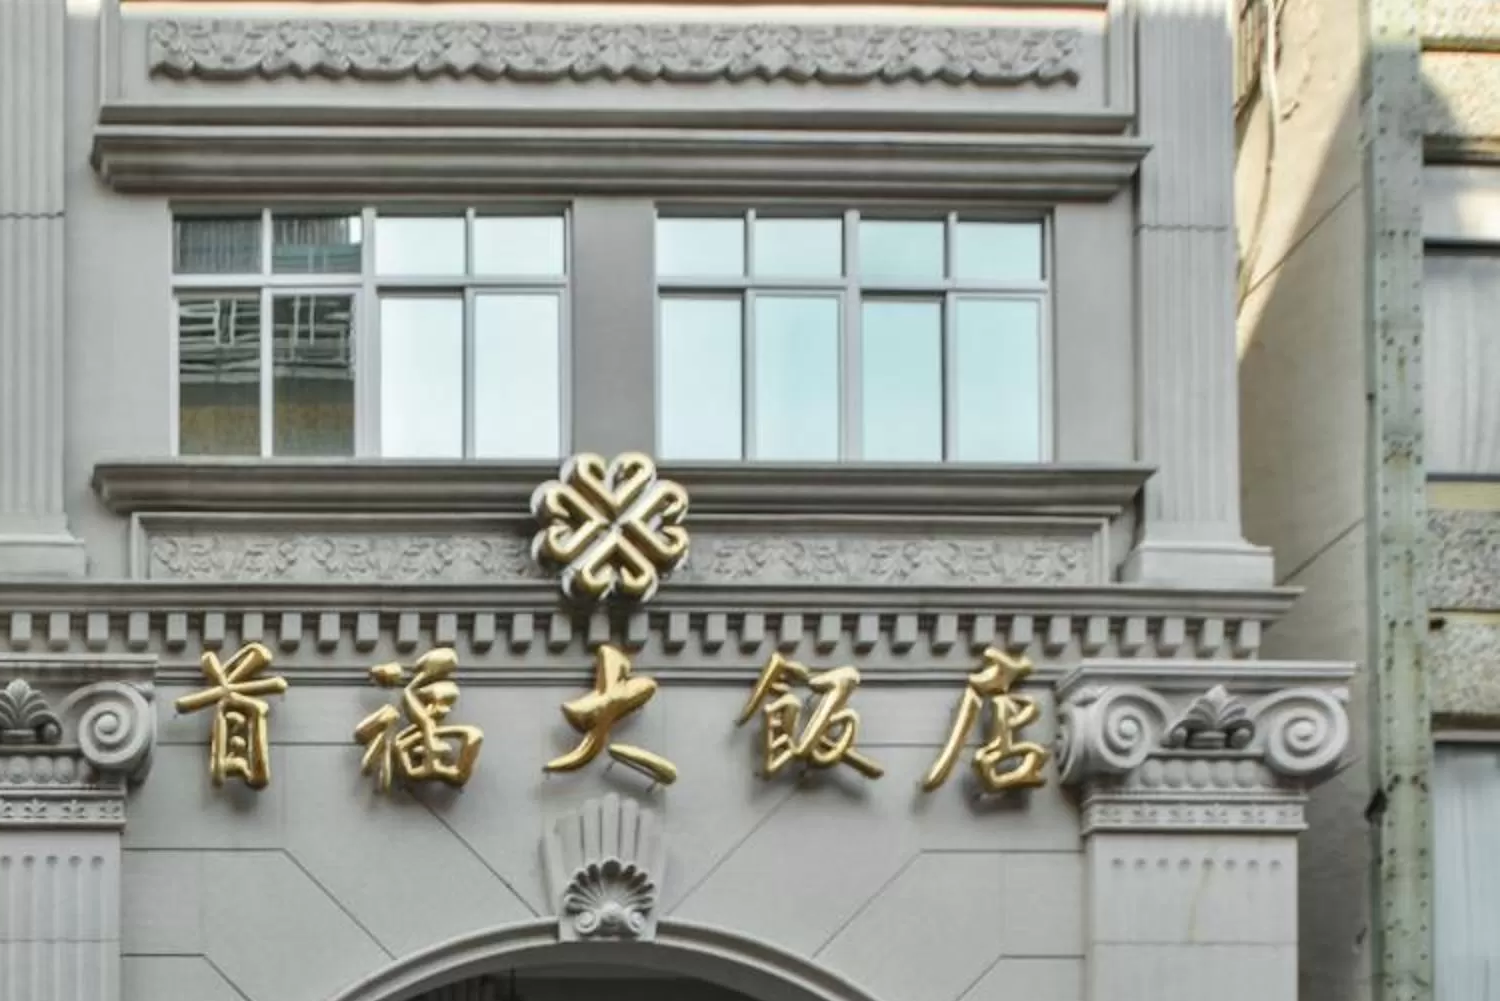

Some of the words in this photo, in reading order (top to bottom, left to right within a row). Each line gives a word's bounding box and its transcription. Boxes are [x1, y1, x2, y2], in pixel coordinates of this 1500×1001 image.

[176, 642, 1054, 793] 首福大飯店
